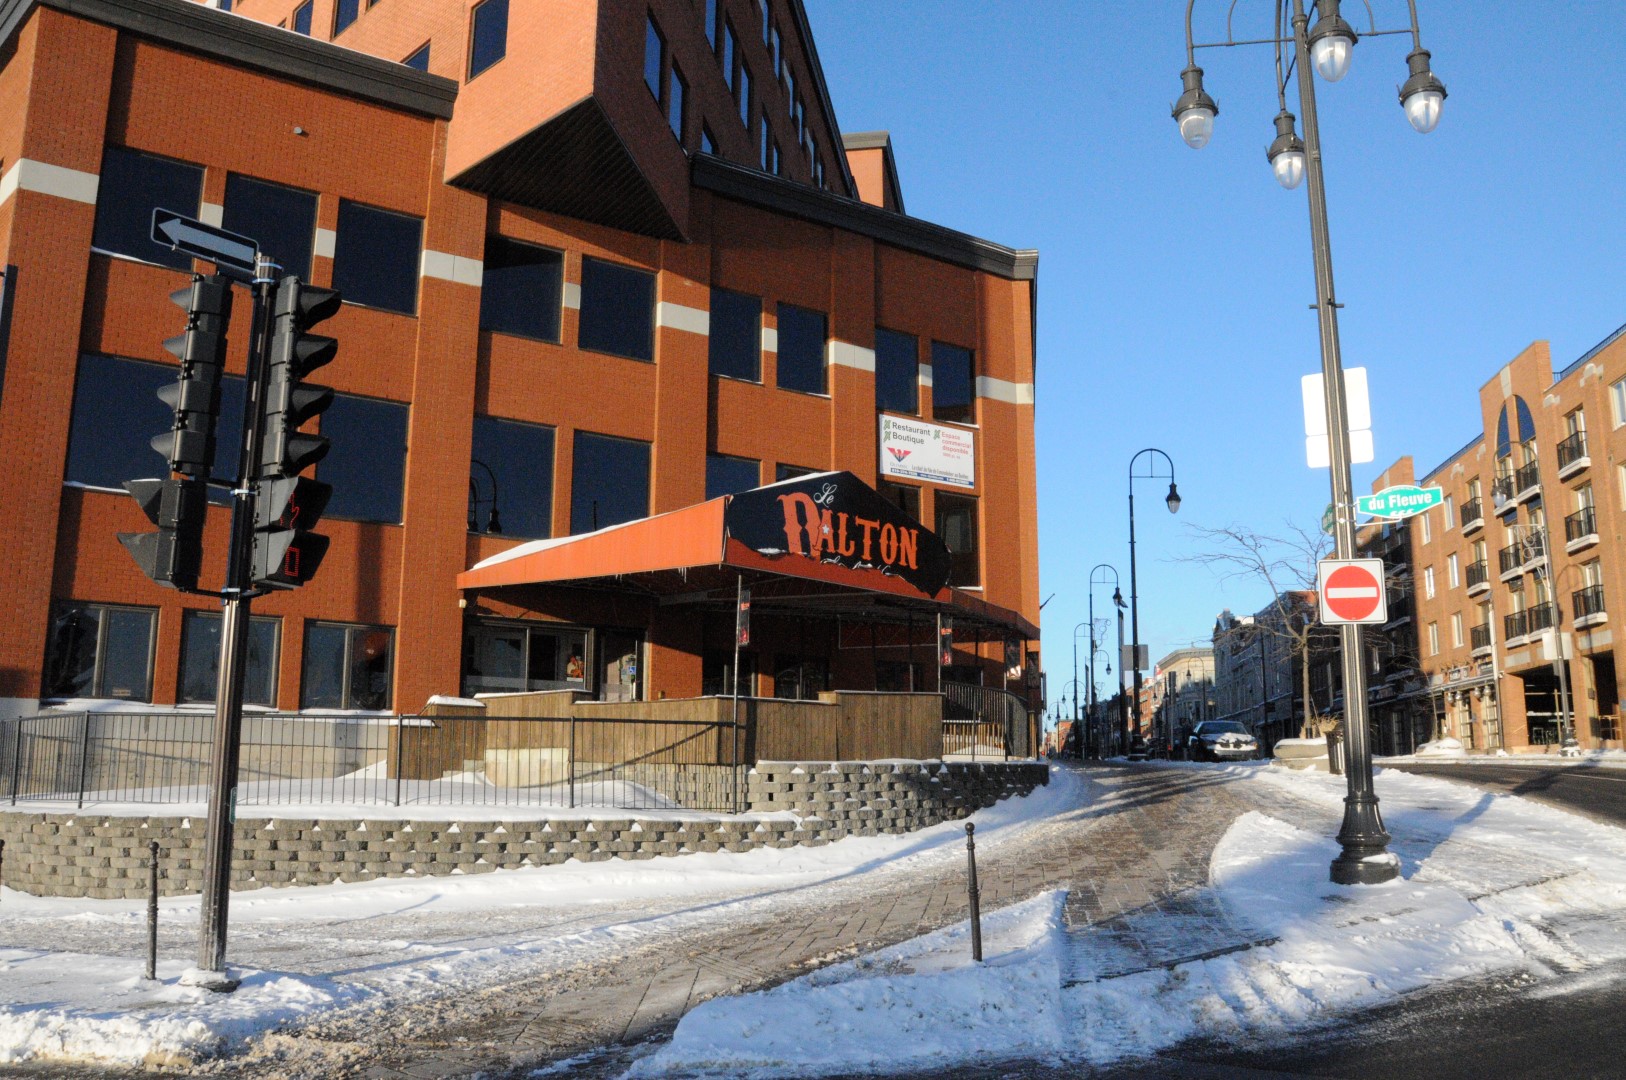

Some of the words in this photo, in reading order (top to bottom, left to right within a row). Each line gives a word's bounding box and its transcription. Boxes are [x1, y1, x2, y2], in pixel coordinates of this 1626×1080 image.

[892, 422, 931, 436] Restaurant
[892, 432, 924, 444] Boutique
[813, 482, 838, 508] Le
[1368, 497, 1385, 510] du
[1388, 492, 1432, 508] Fleuve
[776, 492, 919, 570] DALTON
